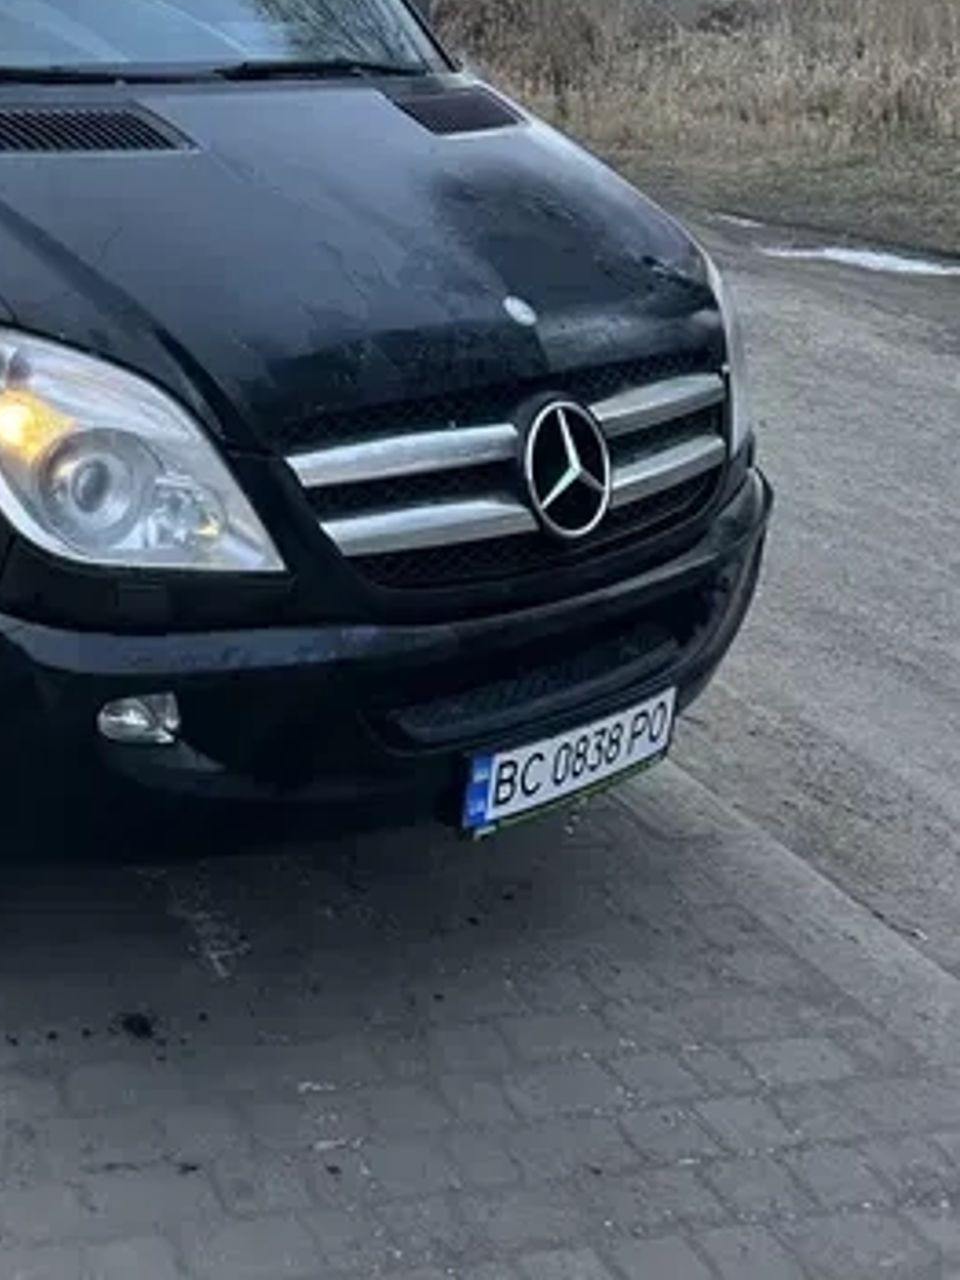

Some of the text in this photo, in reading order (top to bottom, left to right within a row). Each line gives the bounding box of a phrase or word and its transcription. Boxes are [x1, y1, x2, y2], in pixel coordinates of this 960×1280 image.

[494, 701, 668, 806] BC 0838 PO
